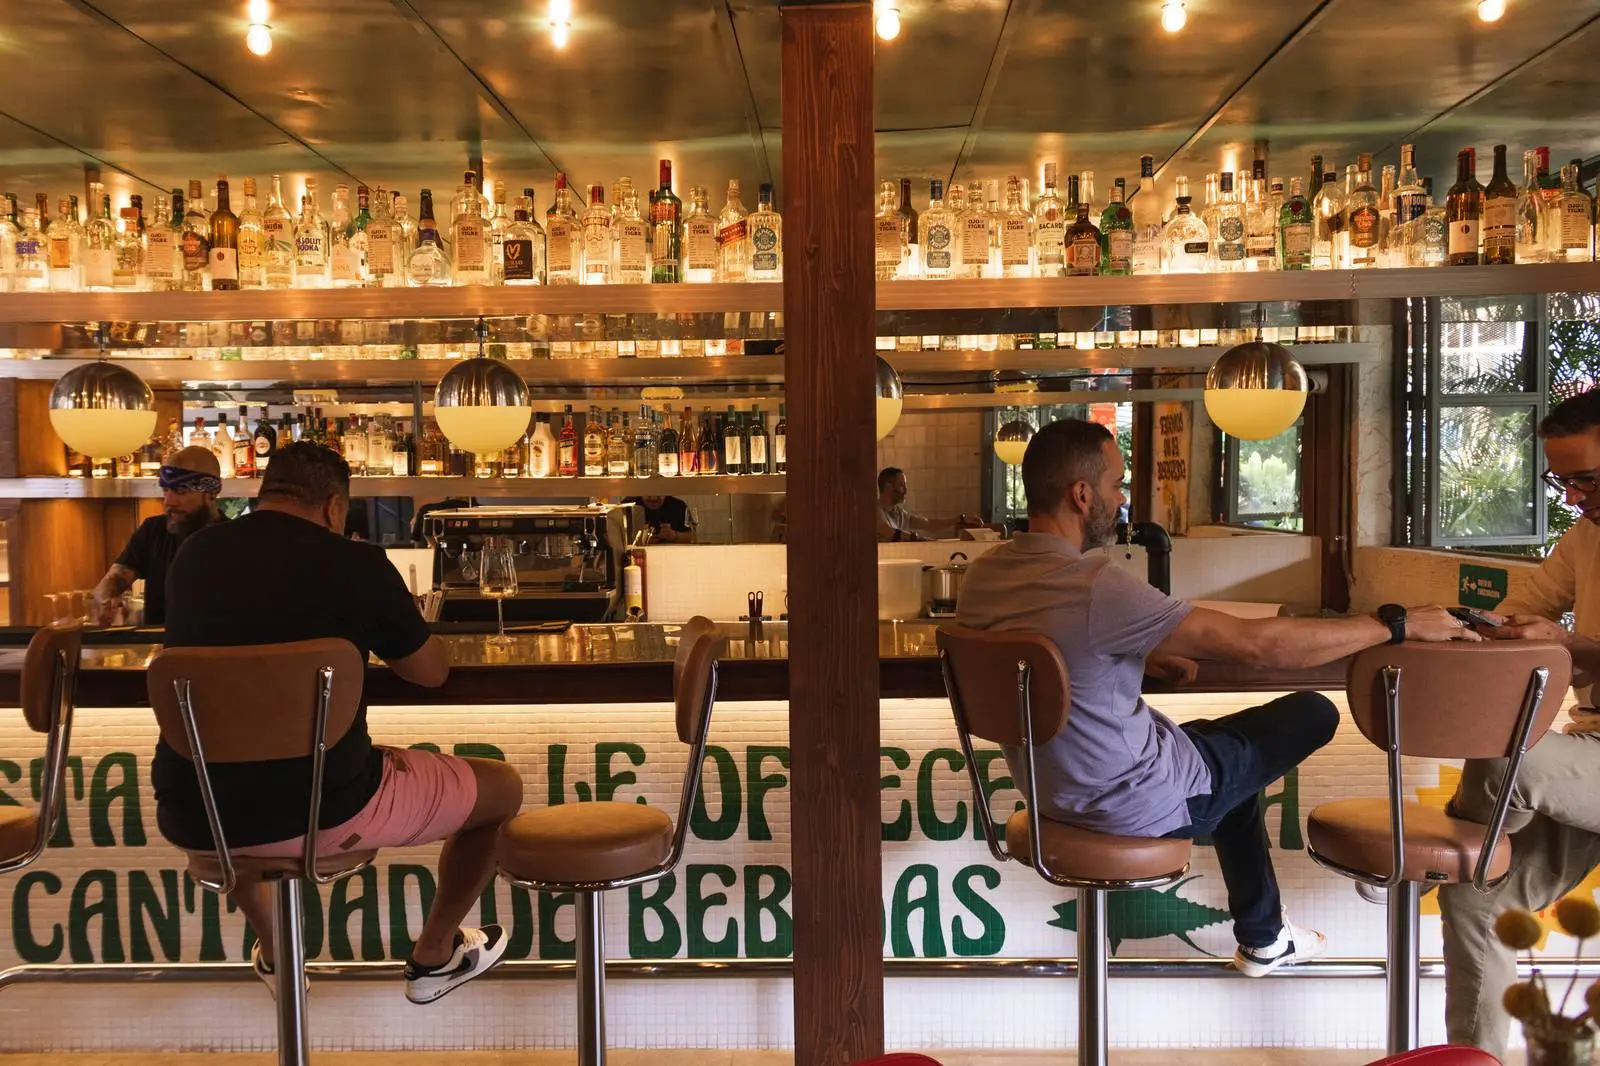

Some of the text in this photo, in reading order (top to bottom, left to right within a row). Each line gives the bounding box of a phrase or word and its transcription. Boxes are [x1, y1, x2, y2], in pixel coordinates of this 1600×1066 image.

[690, 744, 1027, 842] OFECE
[12, 863, 440, 963] CANTAD
[627, 863, 1006, 959] BEBAS
